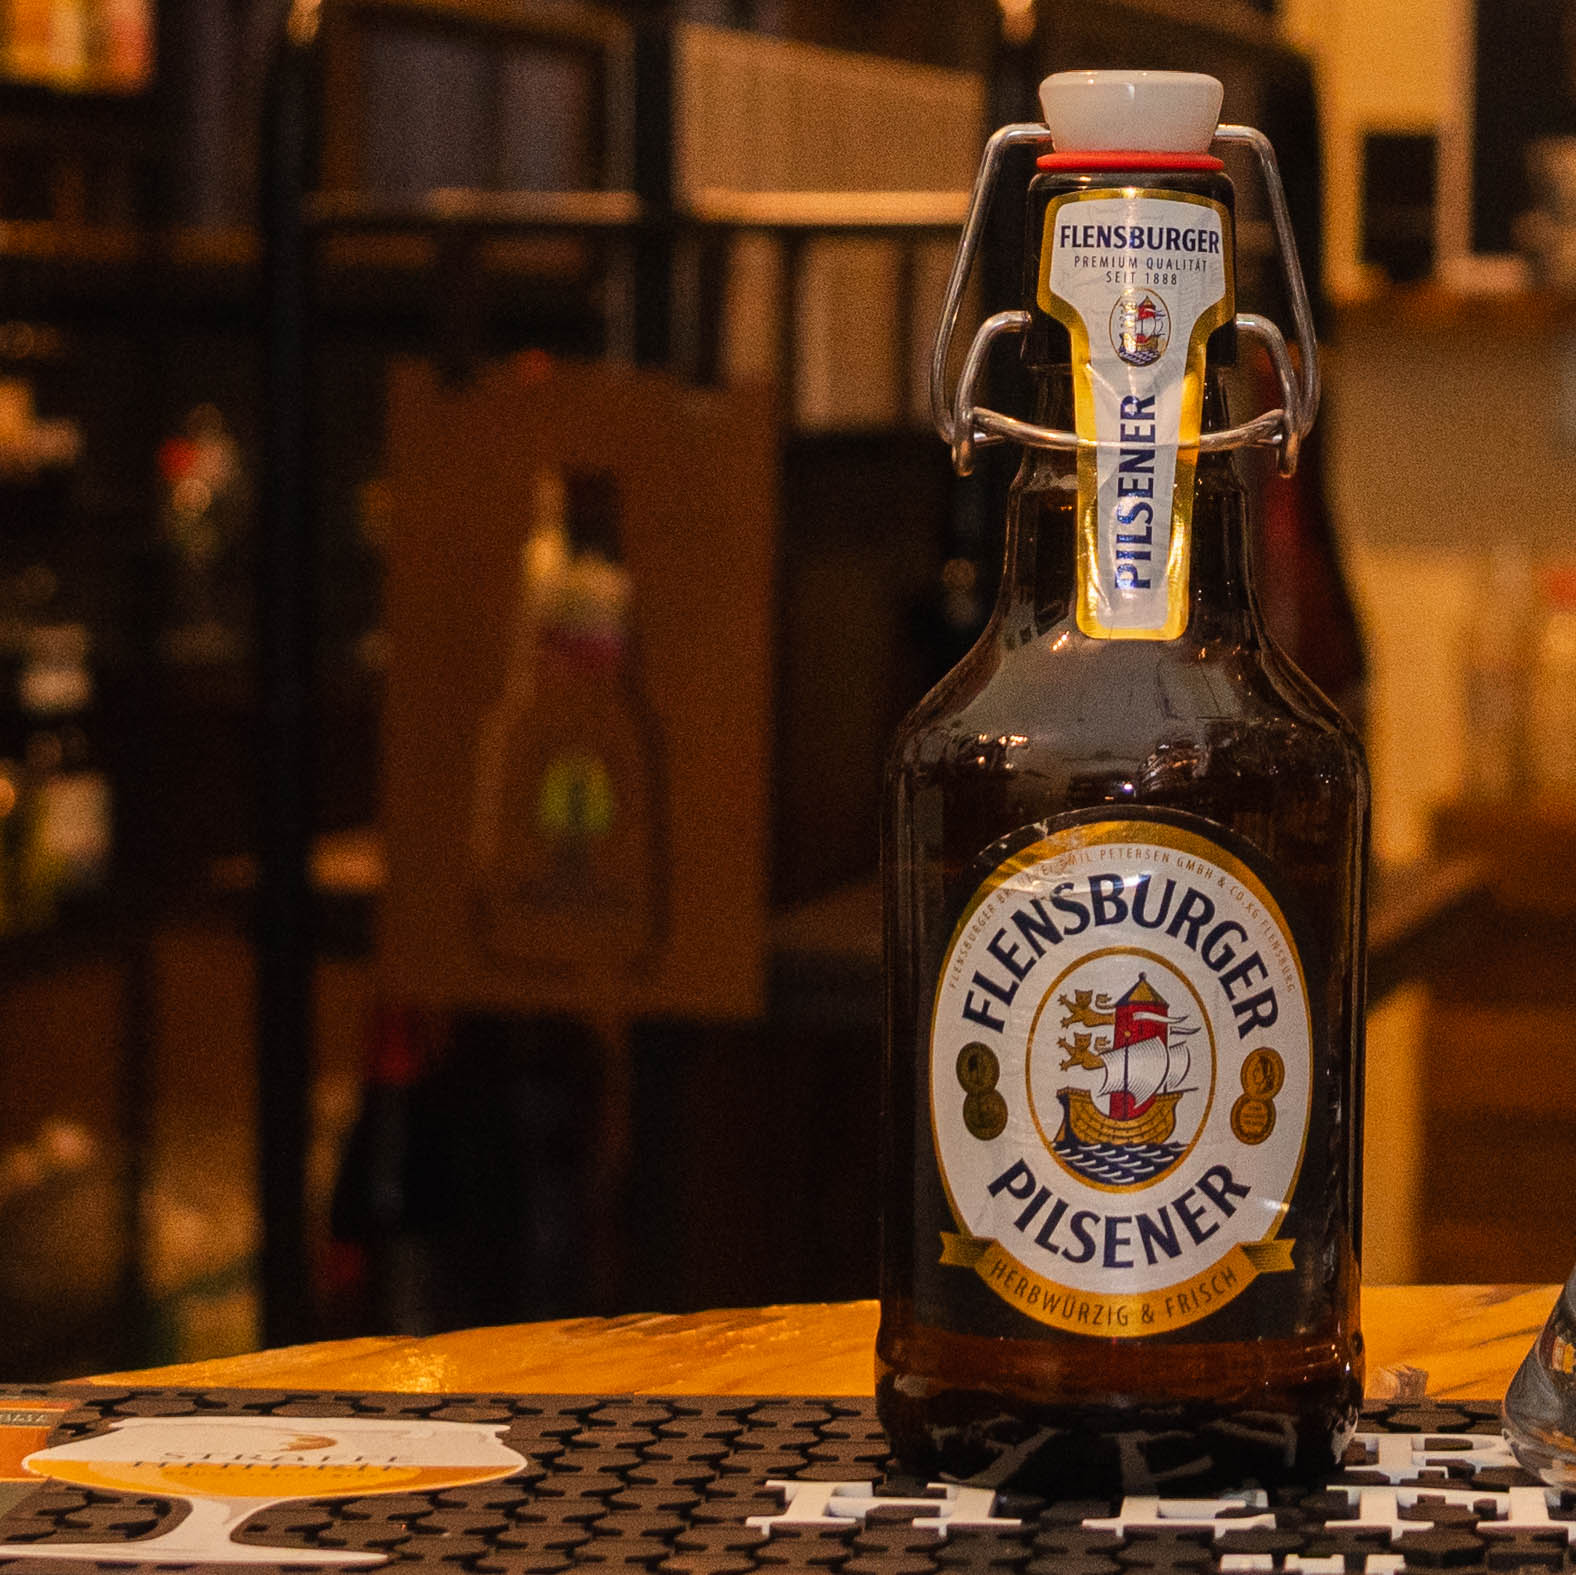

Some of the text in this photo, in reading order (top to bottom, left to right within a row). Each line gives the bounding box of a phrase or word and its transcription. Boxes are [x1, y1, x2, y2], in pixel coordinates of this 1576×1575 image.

[1060, 225, 1220, 254] FLENSBURGER
[1074, 255, 1138, 269] PREMIUM
[1106, 270, 1178, 286] SEIT 1888
[1115, 393, 1157, 590] PILSENER
[1099, 847, 1170, 863] PETERSEN
[1176, 857, 1214, 880] GMBH
[962, 873, 1279, 1040] FLENSBURGER
[987, 1158, 1252, 1269] PILSENER
[990, 1258, 1239, 1326] HERBWÜRZIG & FRISCH
